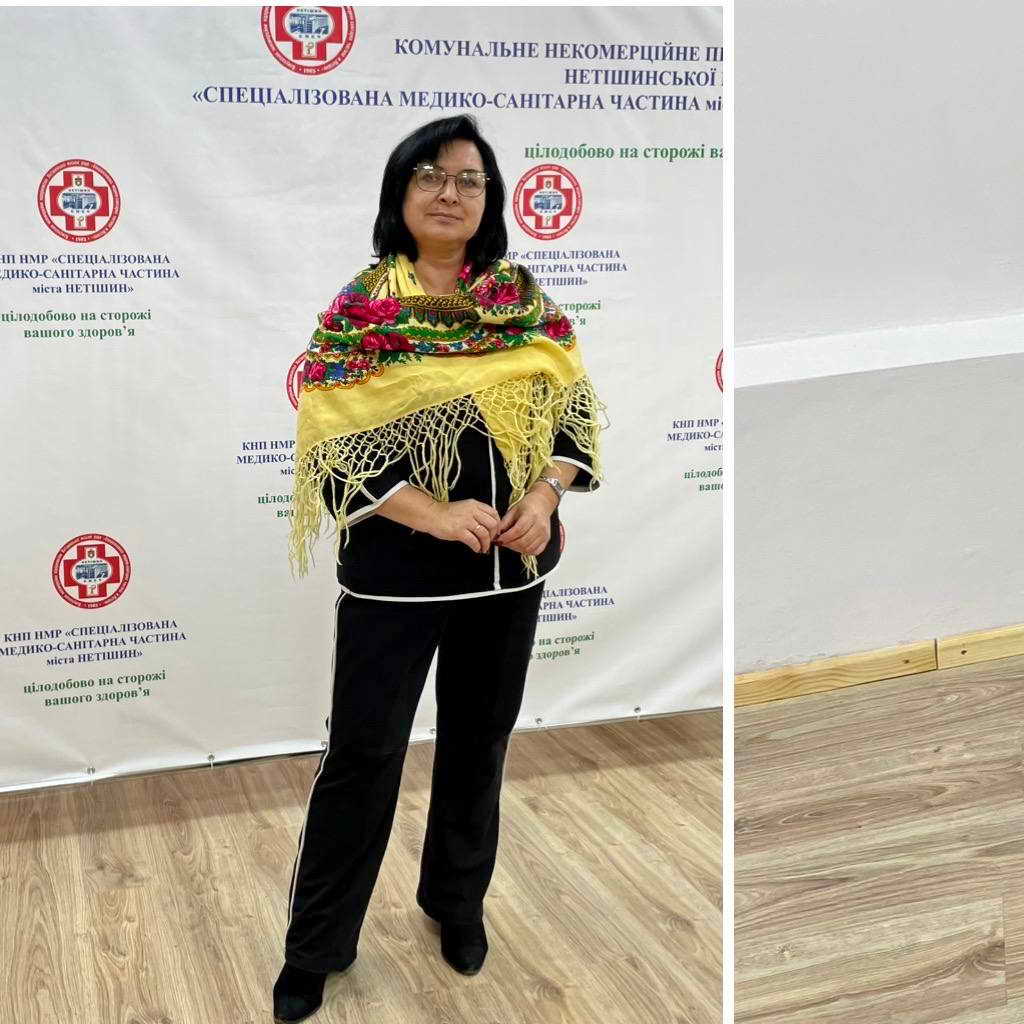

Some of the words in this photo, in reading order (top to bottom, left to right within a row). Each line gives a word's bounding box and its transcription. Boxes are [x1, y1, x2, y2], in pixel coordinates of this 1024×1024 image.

[394, 39, 539, 58] КОМУНАЛЬНЕ
[545, 42, 700, 63] НЕКОМЕРЦІЙНЕ
[565, 68, 716, 86] НЕТІШИНСЬКОЇ
[192, 86, 393, 108] «СПЕЦІАЛІЗОВАНА
[399, 91, 605, 110] МЕДИКО-САНІТАРНА
[610, 94, 700, 111] ЧАСТИНА
[705, 96, 723, 111] мі
[524, 143, 614, 160] цілодобово
[619, 147, 639, 158] на
[643, 144, 705, 162] сторожі
[19, 254, 48, 264] НМР
[51, 254, 170, 265] «СПЕЦІАЛІЗОВАНА
[0, 268, 117, 280] ДИКО-САНІТАРНА
[120, 268, 180, 279] ЧАСТИНА
[576, 263, 627, 272] ЧАСТИНА
[32, 283, 62, 293] міста
[65, 283, 134, 293] НЕТІШИН»
[1, 309, 76, 322] цілодобово
[81, 311, 96, 321] на
[100, 309, 152, 323] сторожі
[24, 328, 74, 338] вашого
[672, 420, 695, 429] КНП
[696, 418, 719, 428] НМР
[666, 430, 723, 442] МЕДИКО-С
[242, 441, 267, 451] КНП
[270, 439, 296, 450] НМР
[704, 443, 723, 452] міст
[539, 601, 563, 610] РНА
[566, 597, 615, 609] ЧАСТИНА
[4, 632, 31, 643] КНП
[34, 629, 61, 640] НМР
[65, 620, 178, 638] «СПЕЦІАЛІЗОВАНА
[130, 632, 187, 645] ЧАСТИНА
[554, 632, 594, 645] сторожі
[46, 656, 75, 666] міста
[24, 678, 94, 694] цілодобово
[99, 677, 113, 686] на
[118, 669, 166, 685] сторожі
[45, 694, 92, 707] вашого
